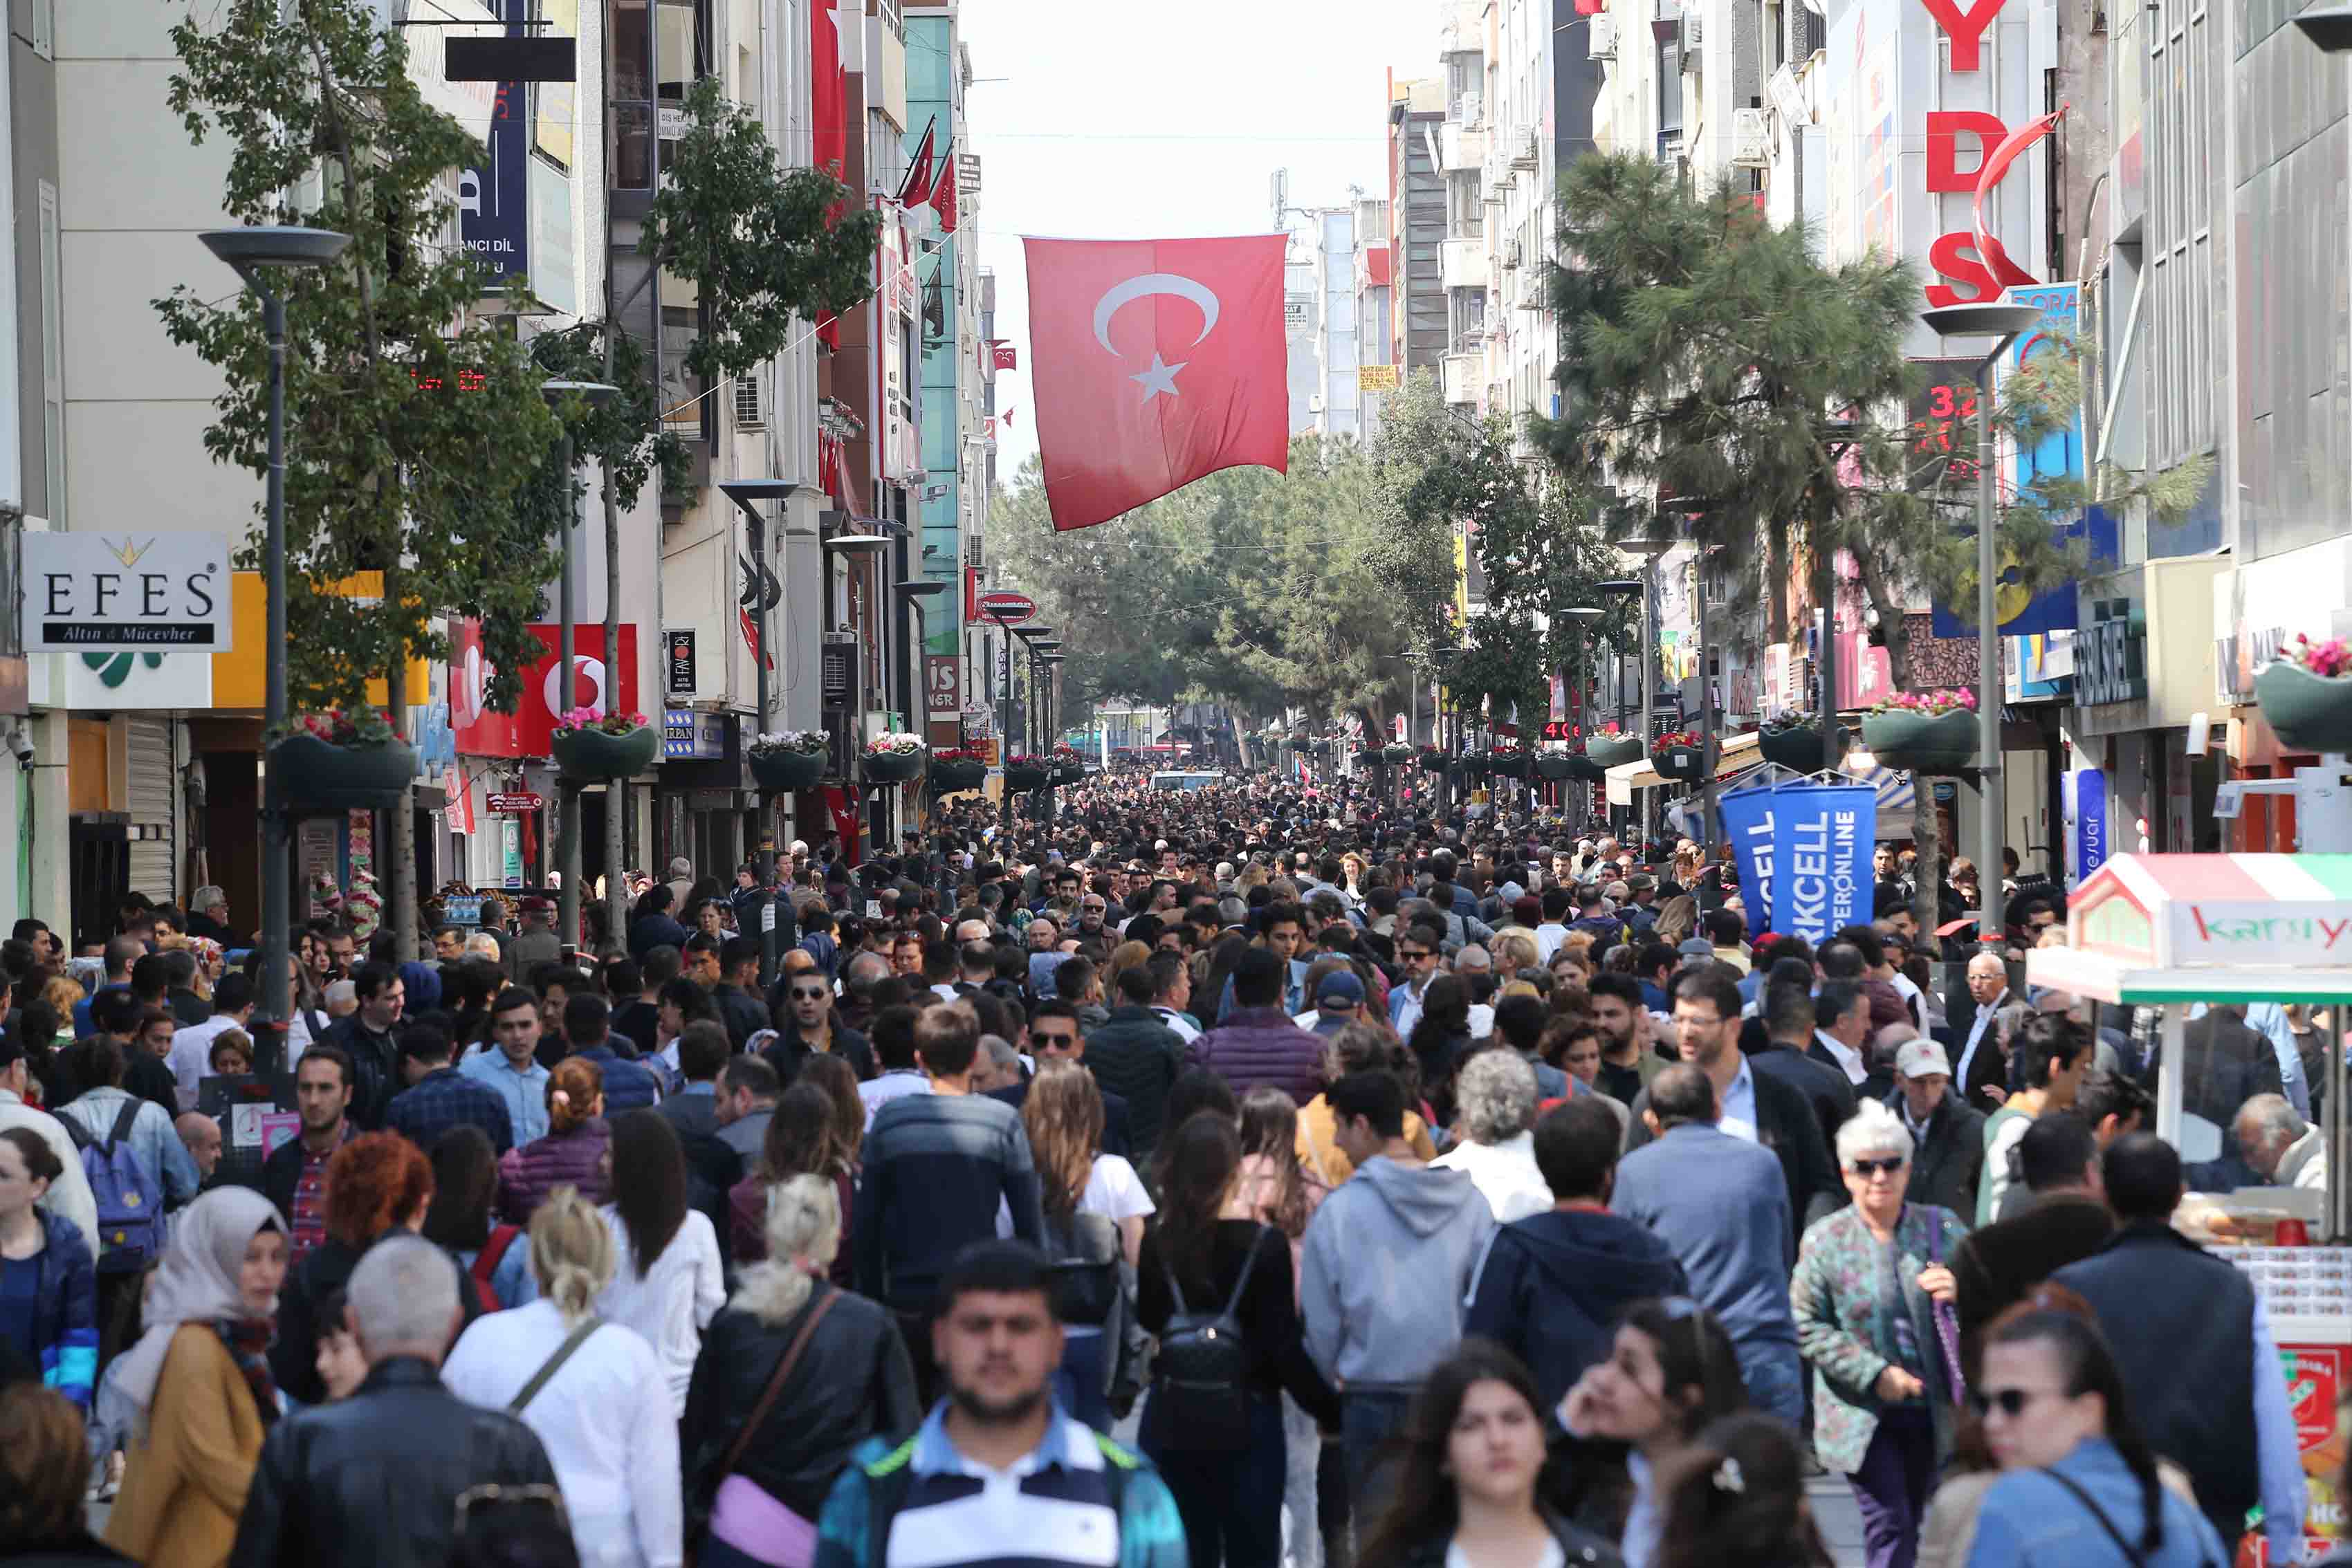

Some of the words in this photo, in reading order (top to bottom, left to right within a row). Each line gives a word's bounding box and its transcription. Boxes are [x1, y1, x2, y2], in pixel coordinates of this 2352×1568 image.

[493, 238, 515, 252] DİL
[43, 573, 214, 617] EFES
[122, 625, 195, 641] Mücevher
